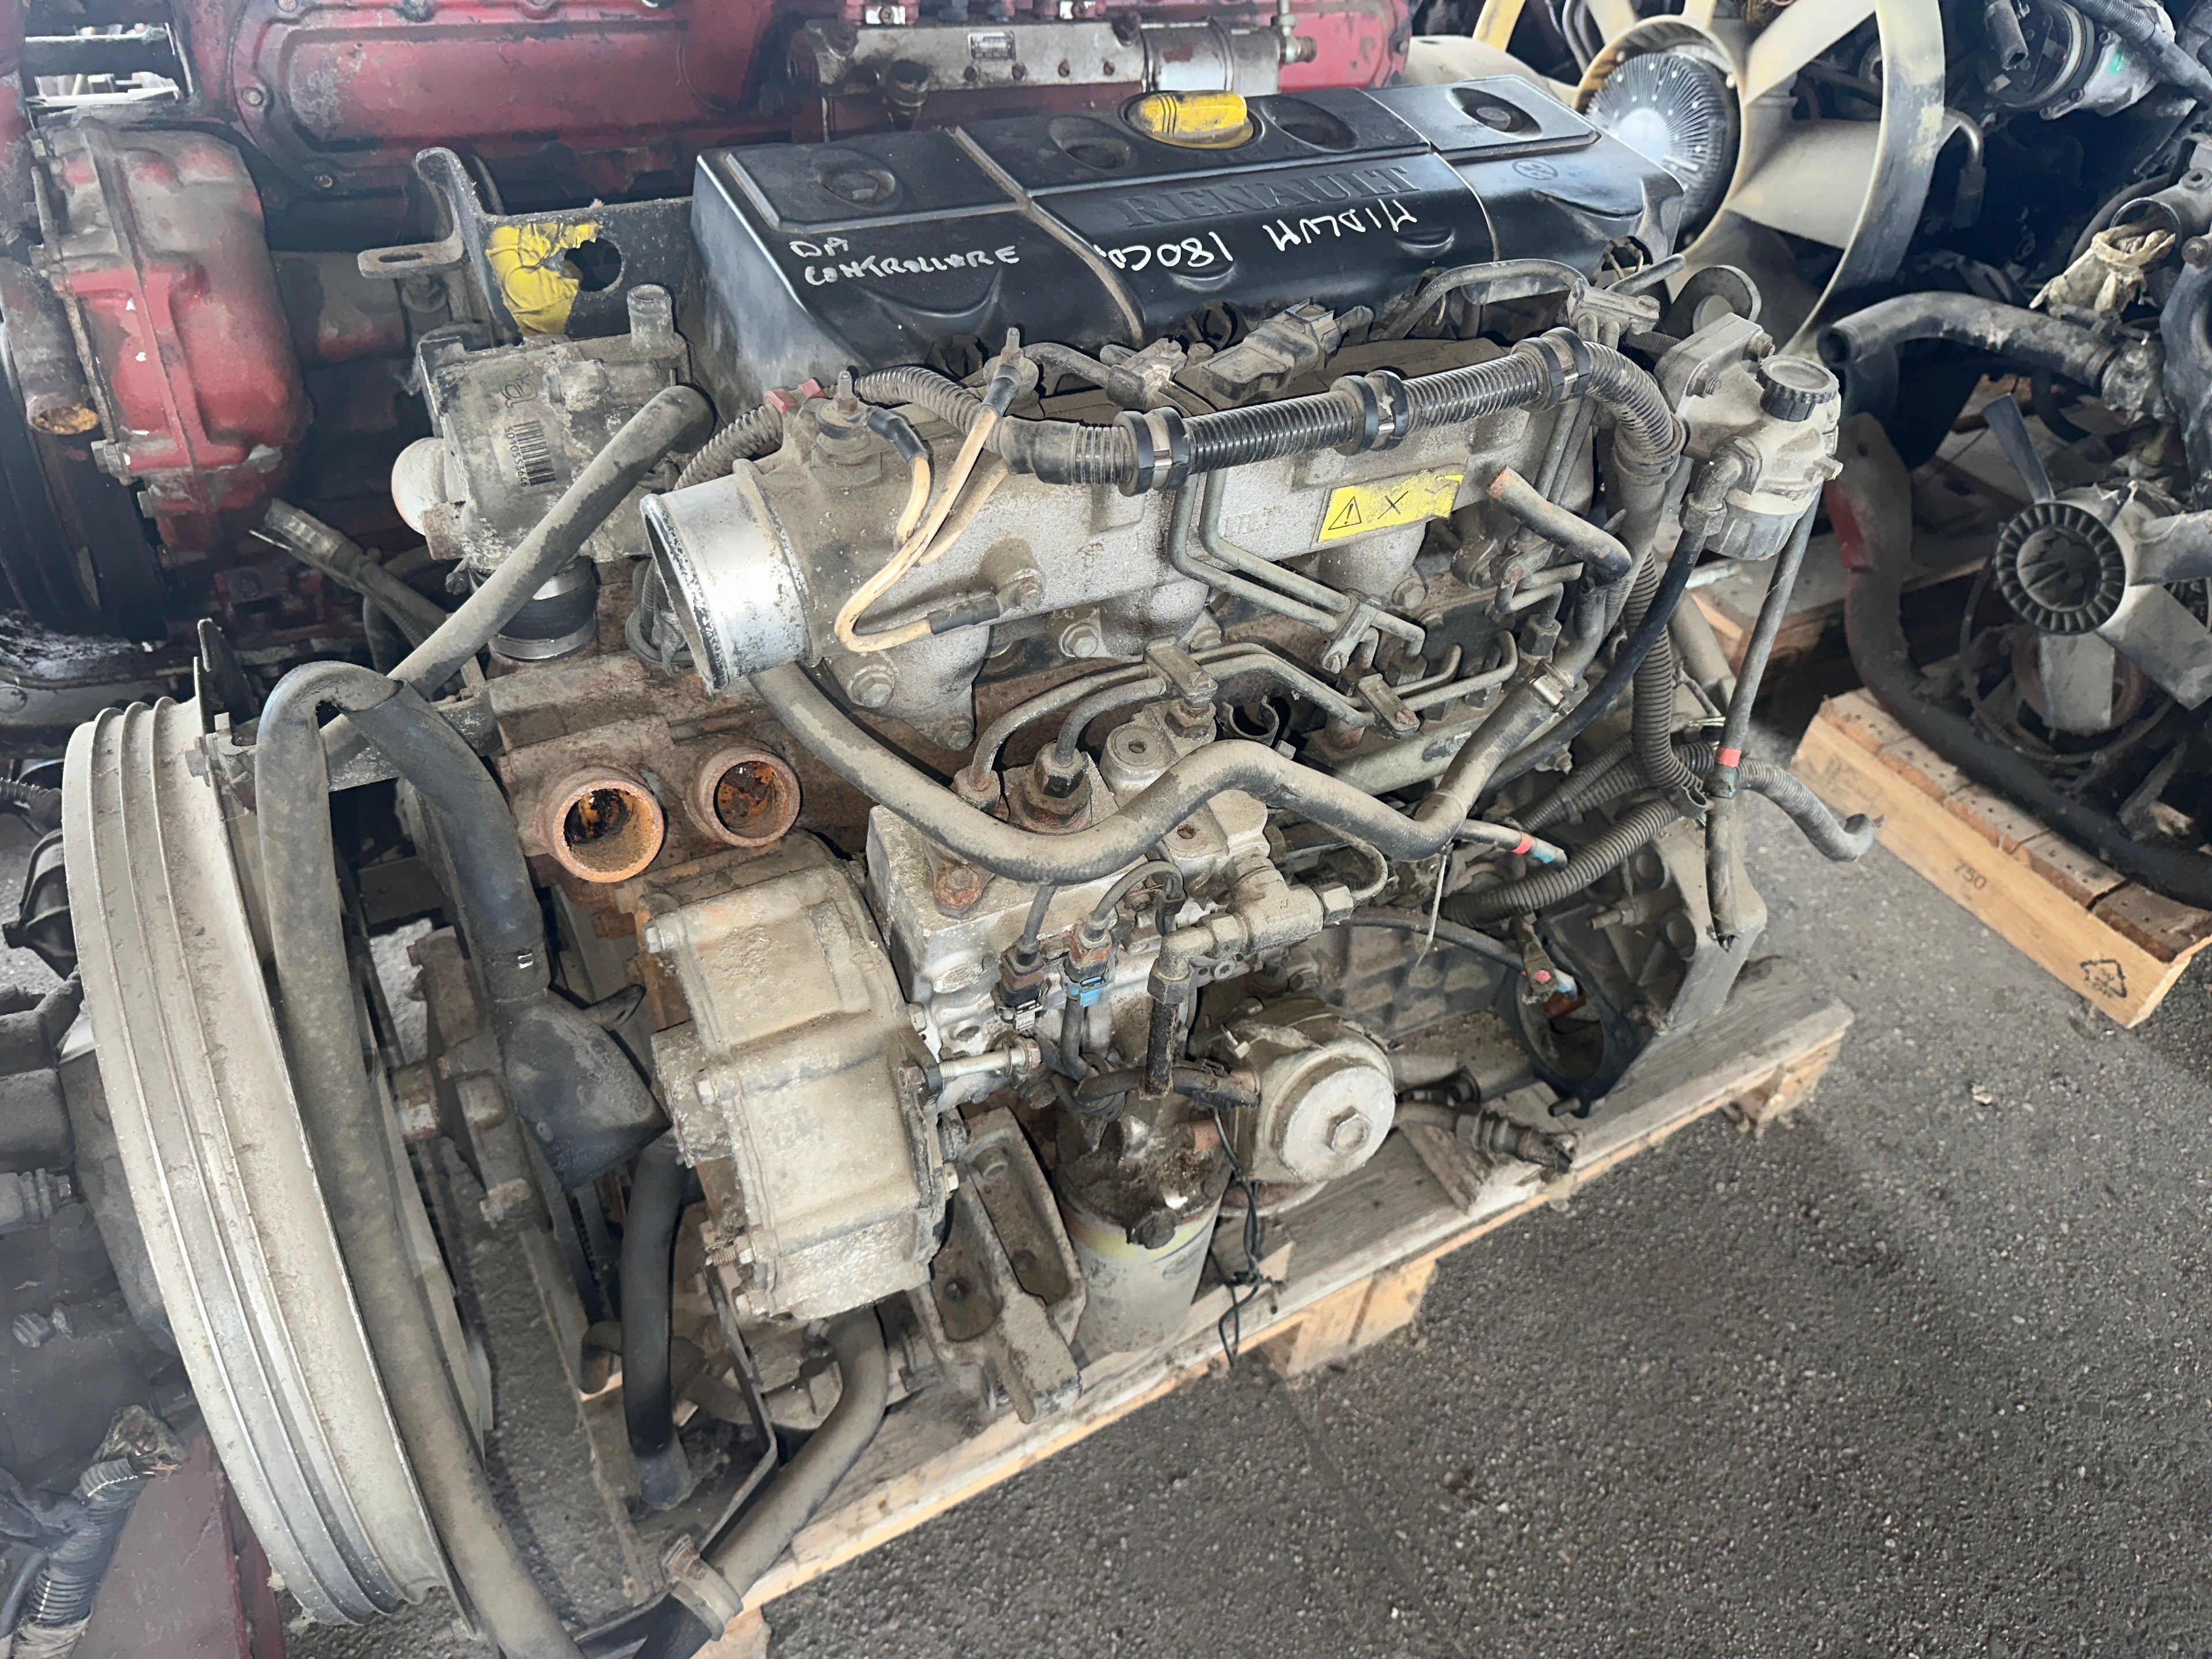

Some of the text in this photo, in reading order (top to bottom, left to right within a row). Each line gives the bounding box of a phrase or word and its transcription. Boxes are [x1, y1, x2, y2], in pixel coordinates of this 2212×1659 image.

[1113, 165, 1422, 228] RENAULT
[789, 237, 849, 257] DA
[1262, 198, 1417, 252] MIDLUM
[805, 245, 1020, 286] CONTROLLARE
[504, 426, 529, 487] 5010553646
